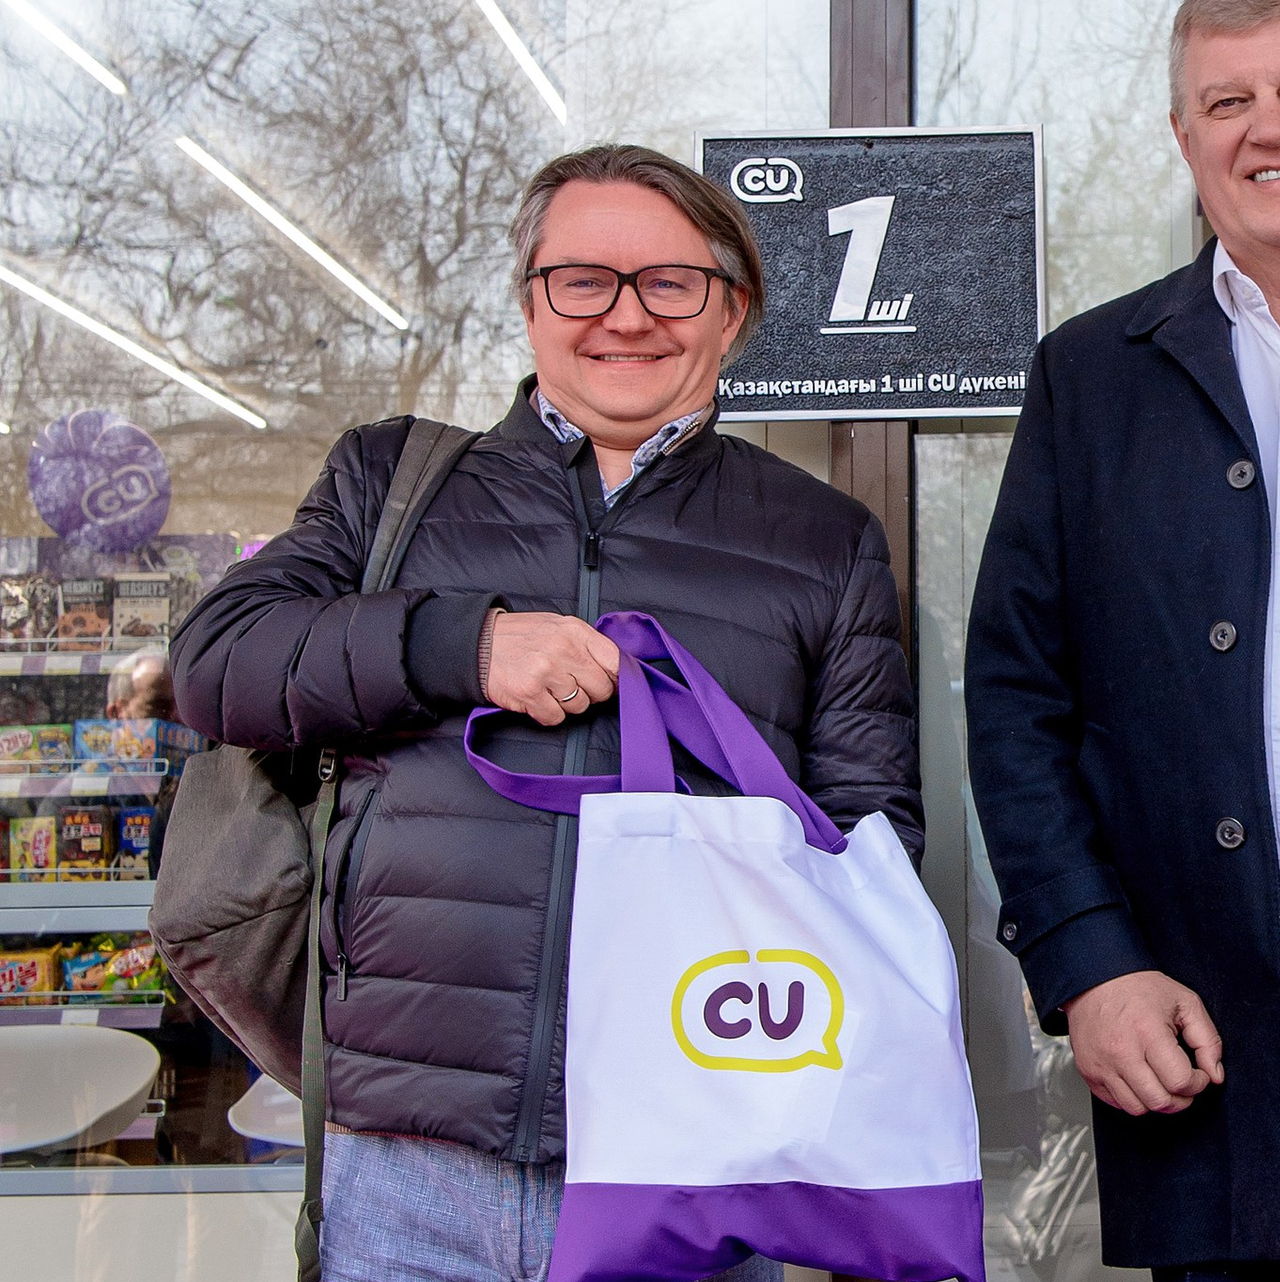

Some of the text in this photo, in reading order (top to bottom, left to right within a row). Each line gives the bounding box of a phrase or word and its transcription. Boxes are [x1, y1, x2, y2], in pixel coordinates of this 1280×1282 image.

[744, 168, 789, 192] CU
[718, 371, 1025, 399] Қазақстандағы 1 ші CU дүкені
[97, 475, 144, 514] CU
[703, 980, 805, 1041] CU
